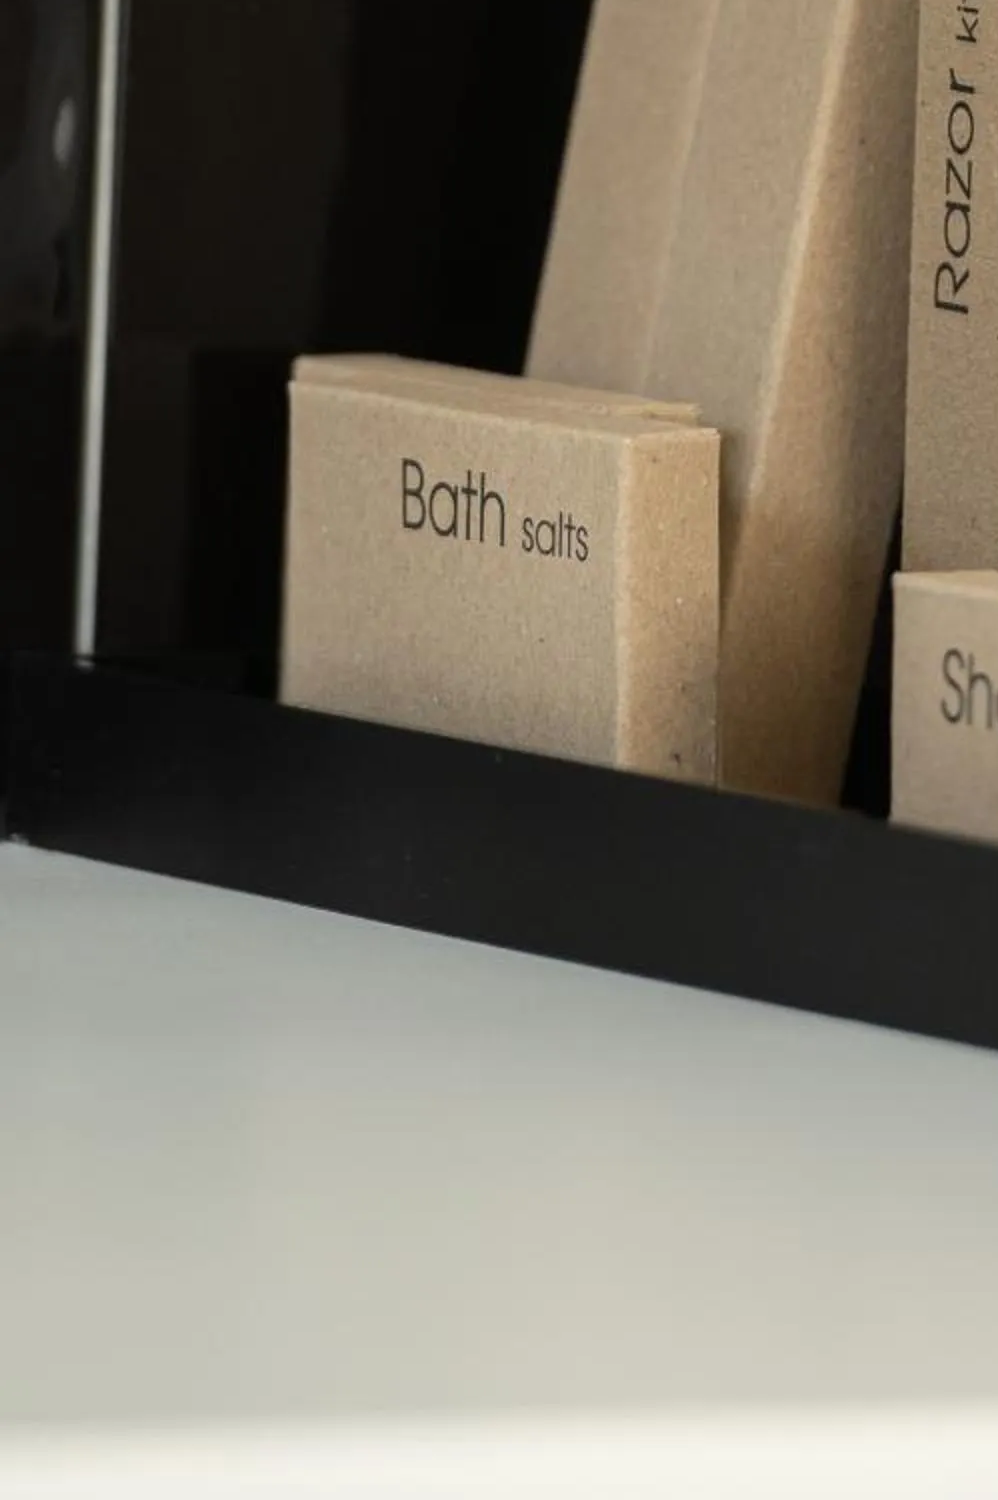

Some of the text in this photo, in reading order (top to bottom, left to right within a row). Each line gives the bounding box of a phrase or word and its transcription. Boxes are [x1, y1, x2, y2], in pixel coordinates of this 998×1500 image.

[934, 66, 977, 315] Razor
[400, 457, 590, 563] Bath salts
